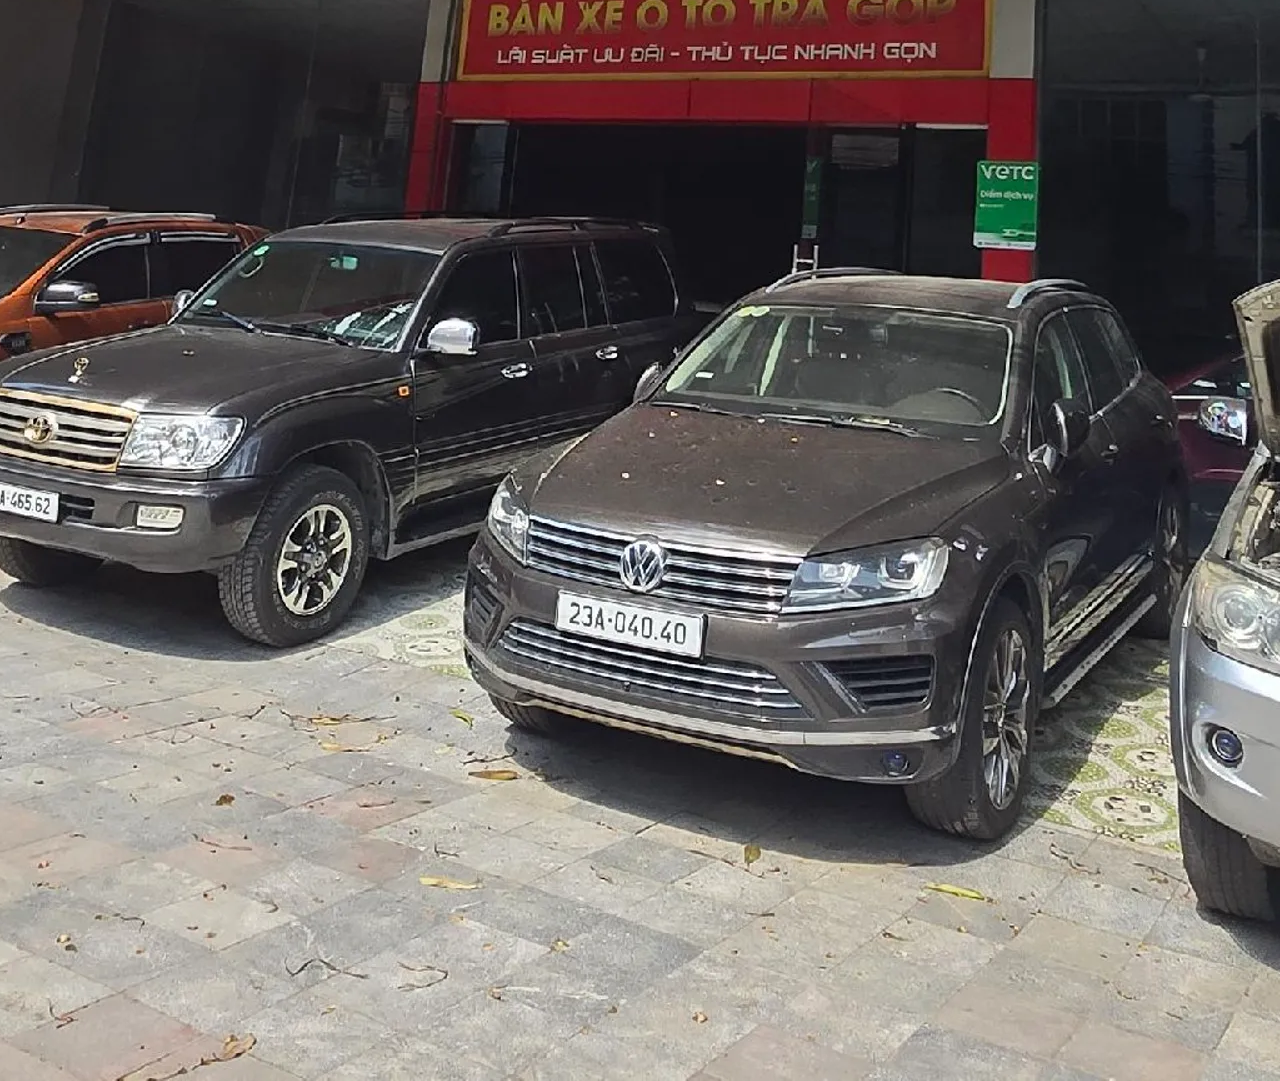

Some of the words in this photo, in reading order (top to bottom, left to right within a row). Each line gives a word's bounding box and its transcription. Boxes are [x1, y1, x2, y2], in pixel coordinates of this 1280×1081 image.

[575, 0, 624, 35] XE
[497, 45, 526, 64] LÃI
[686, 41, 733, 61] THỦ
[740, 44, 787, 64] TỤC
[794, 42, 876, 60] NHANH
[883, 41, 937, 63] GỌN
[569, 601, 687, 645] 23A-040.40
